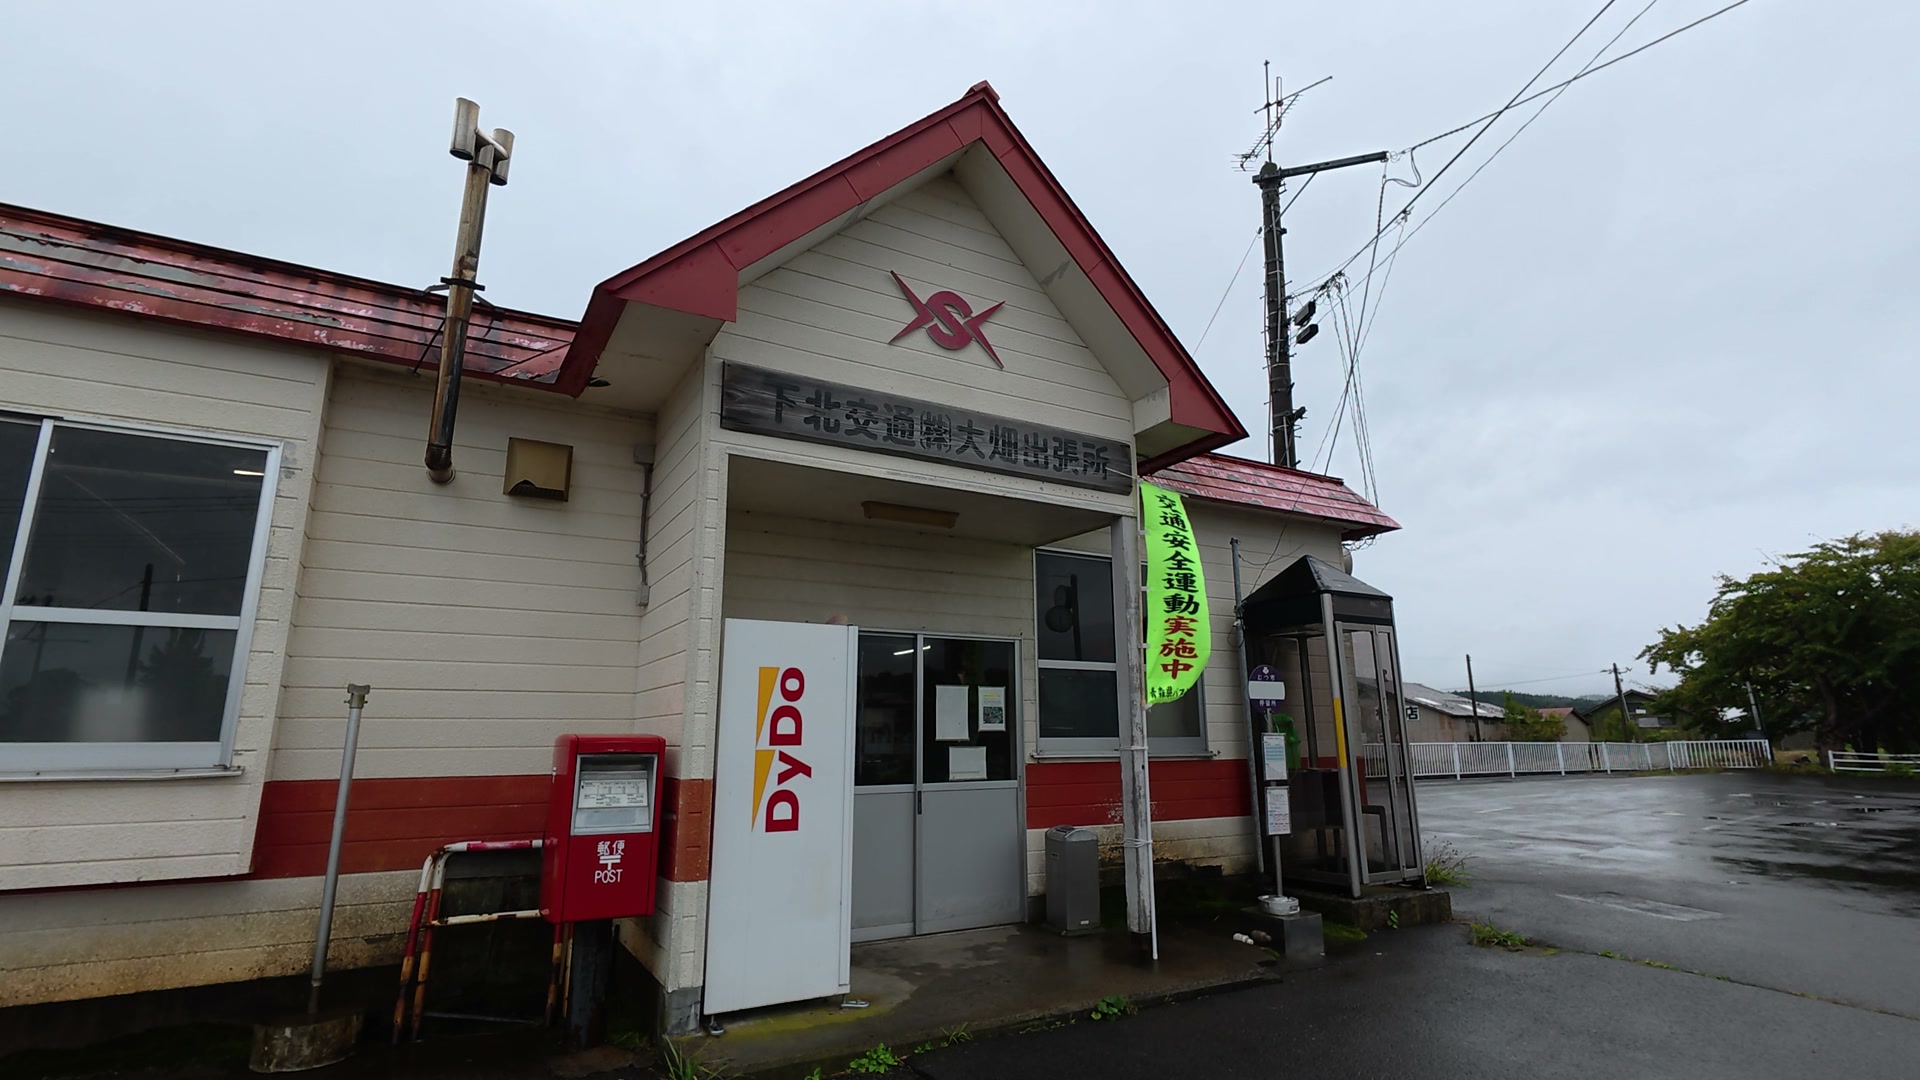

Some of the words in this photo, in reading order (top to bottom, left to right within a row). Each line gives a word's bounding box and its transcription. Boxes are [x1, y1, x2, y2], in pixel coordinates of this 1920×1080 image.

[1156, 494, 1200, 680] 交通安全運動実施中
[765, 667, 812, 832] DyDo
[594, 869, 623, 884] POST
[597, 840, 625, 856] 郵便
